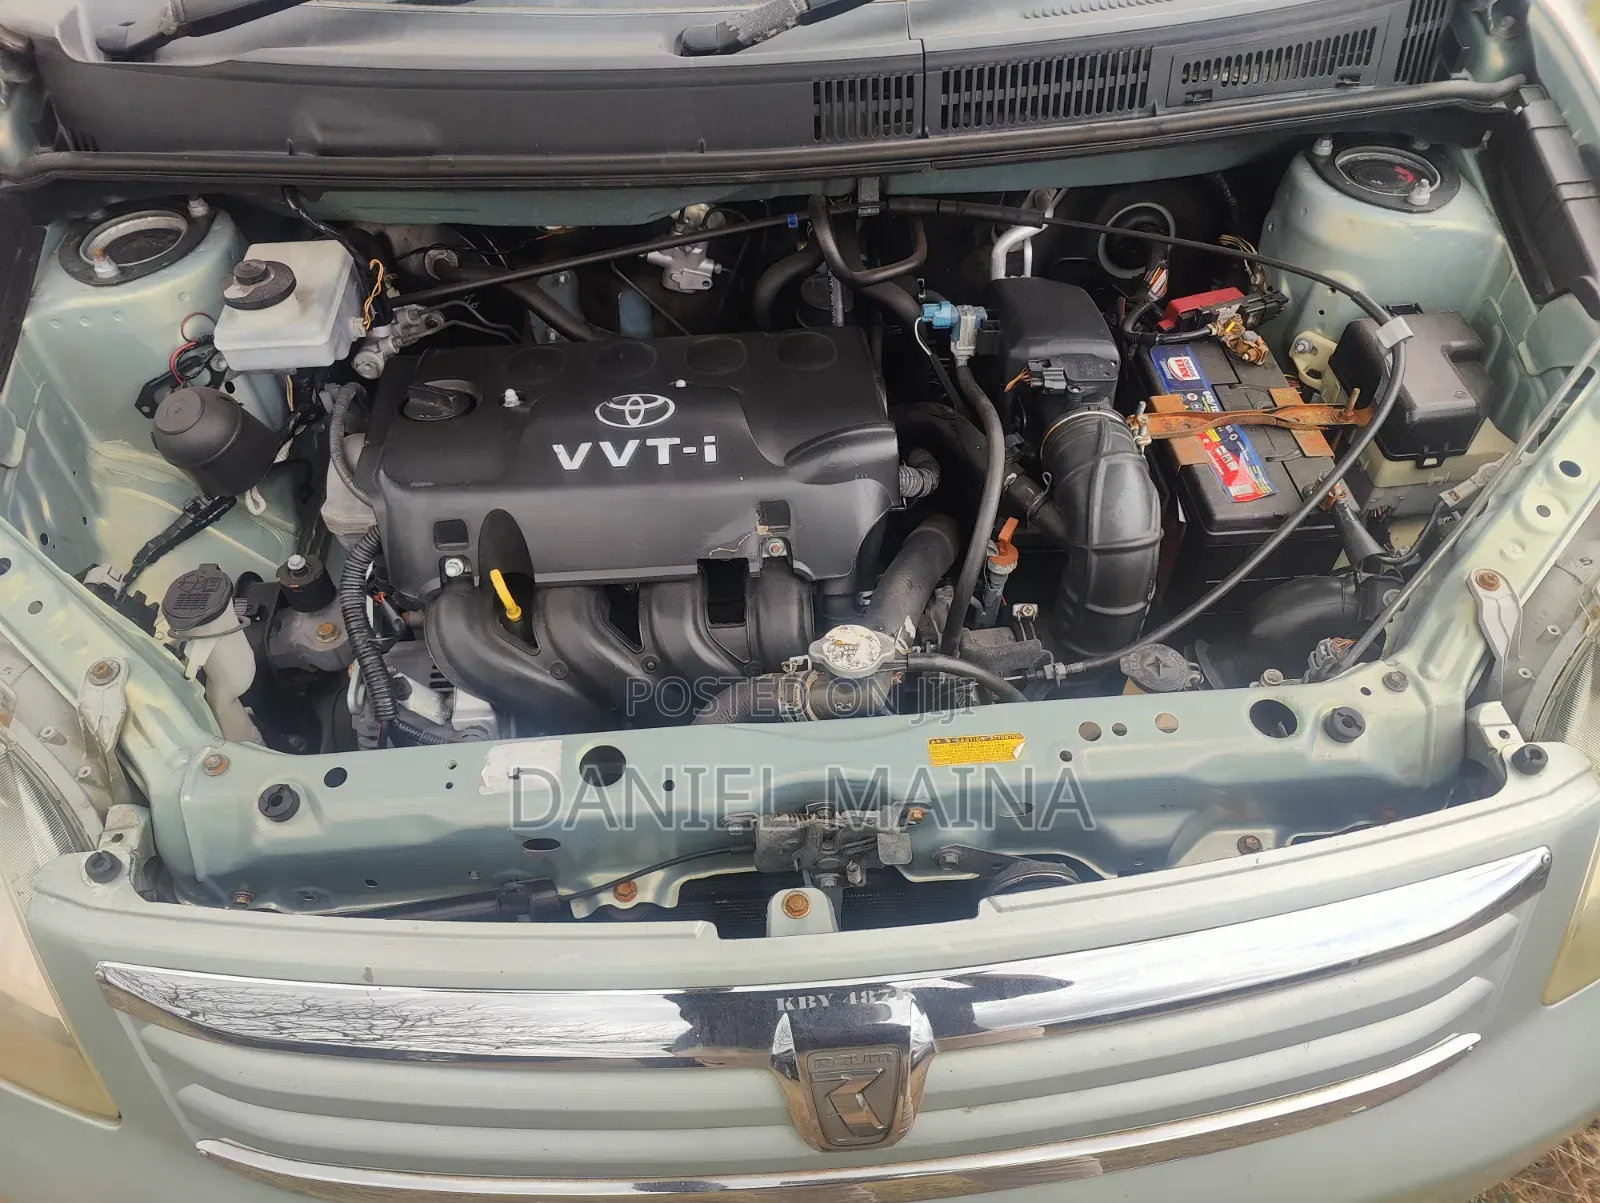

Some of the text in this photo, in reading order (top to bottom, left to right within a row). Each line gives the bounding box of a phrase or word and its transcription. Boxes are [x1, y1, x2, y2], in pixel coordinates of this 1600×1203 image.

[1174, 358, 1191, 380] EXIDE
[552, 435, 718, 471] VVT-i
[990, 733, 1022, 741] ATTENTION
[776, 994, 835, 1012] KBY
